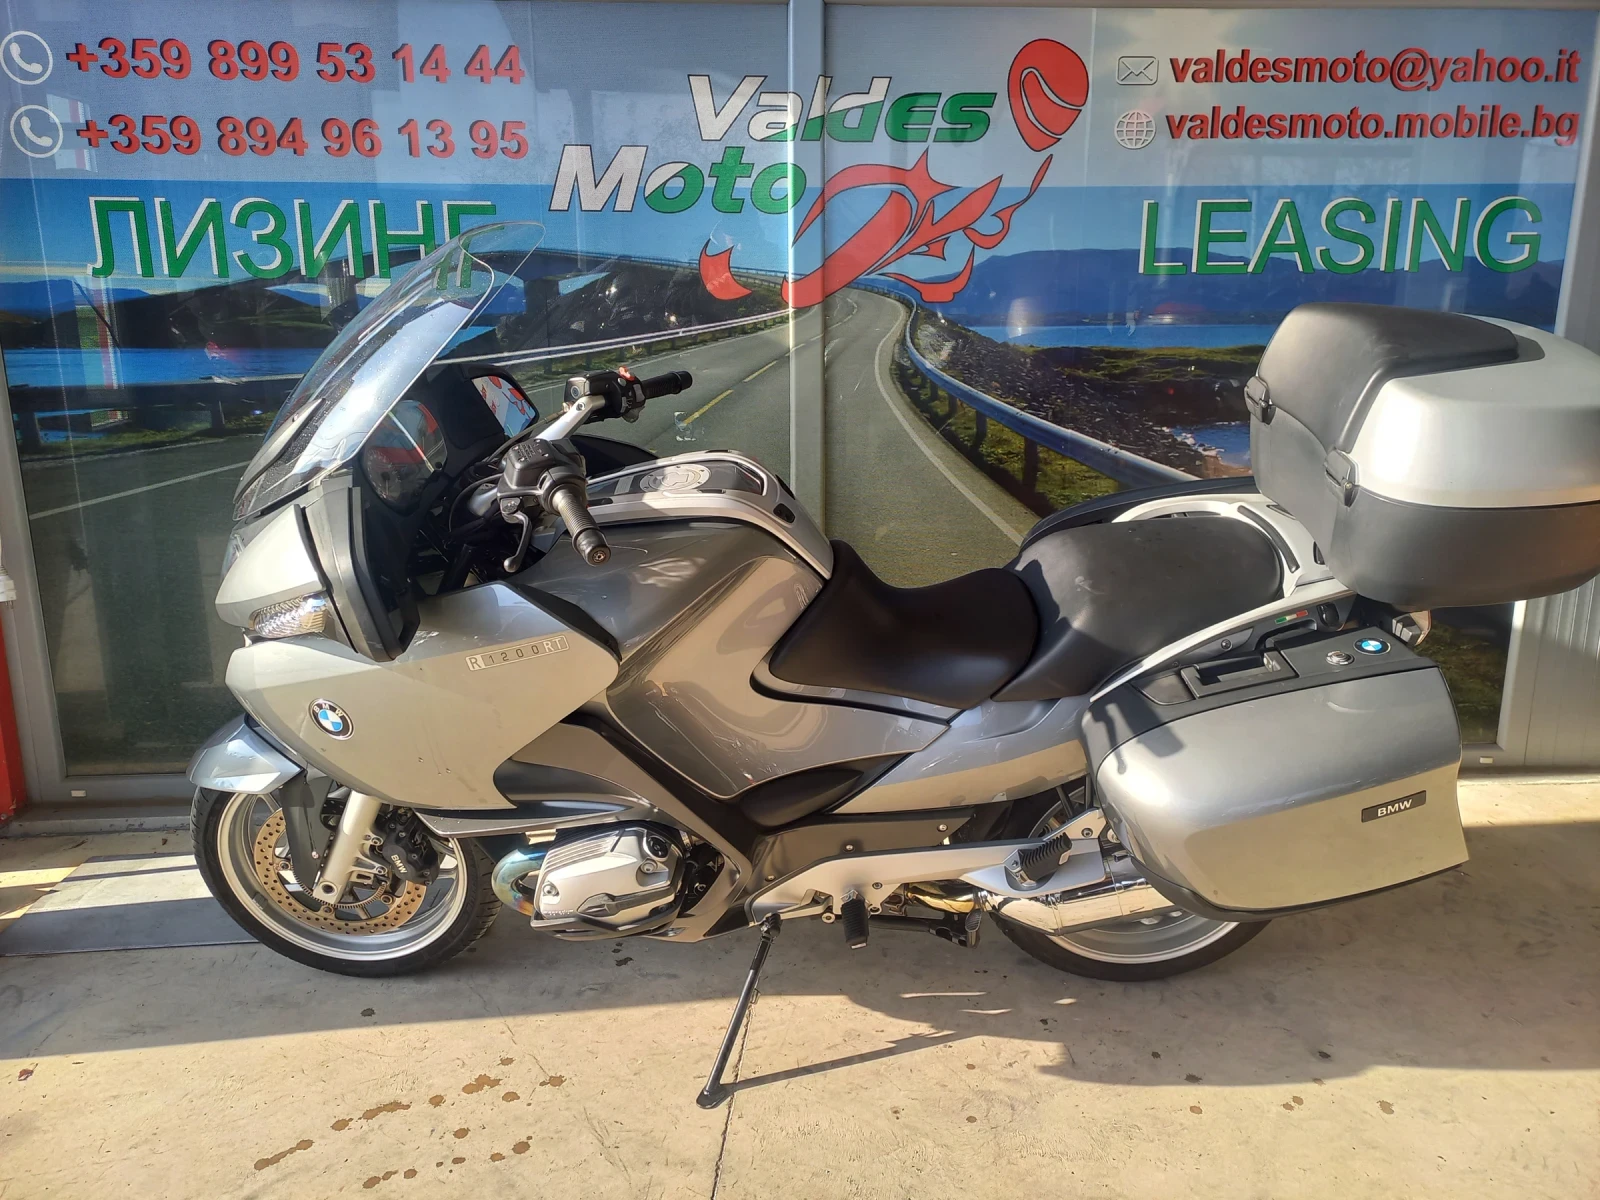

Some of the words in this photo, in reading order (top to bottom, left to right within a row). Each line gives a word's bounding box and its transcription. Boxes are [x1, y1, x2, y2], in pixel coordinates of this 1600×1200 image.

[66, 37, 192, 80] +359
[207, 39, 300, 82] 899
[316, 42, 376, 83] 53
[393, 44, 451, 84] 14
[464, 44, 525, 85] 44
[1169, 47, 1581, 92] valdesmoto@yahoo.it
[687, 74, 997, 142] Valdes
[1166, 105, 1579, 147] valdesmoto.mobile.bg
[76, 114, 201, 155] +359
[217, 117, 308, 157] 894
[322, 118, 382, 158] 96
[398, 120, 456, 159] 13
[470, 120, 529, 159] 95
[548, 145, 807, 214] Moto
[87, 196, 497, 281] ЛИЗИНГ
[1138, 196, 1544, 276] LEASING
[1377, 798, 1413, 817] BMW
[391, 854, 408, 874] BMW
